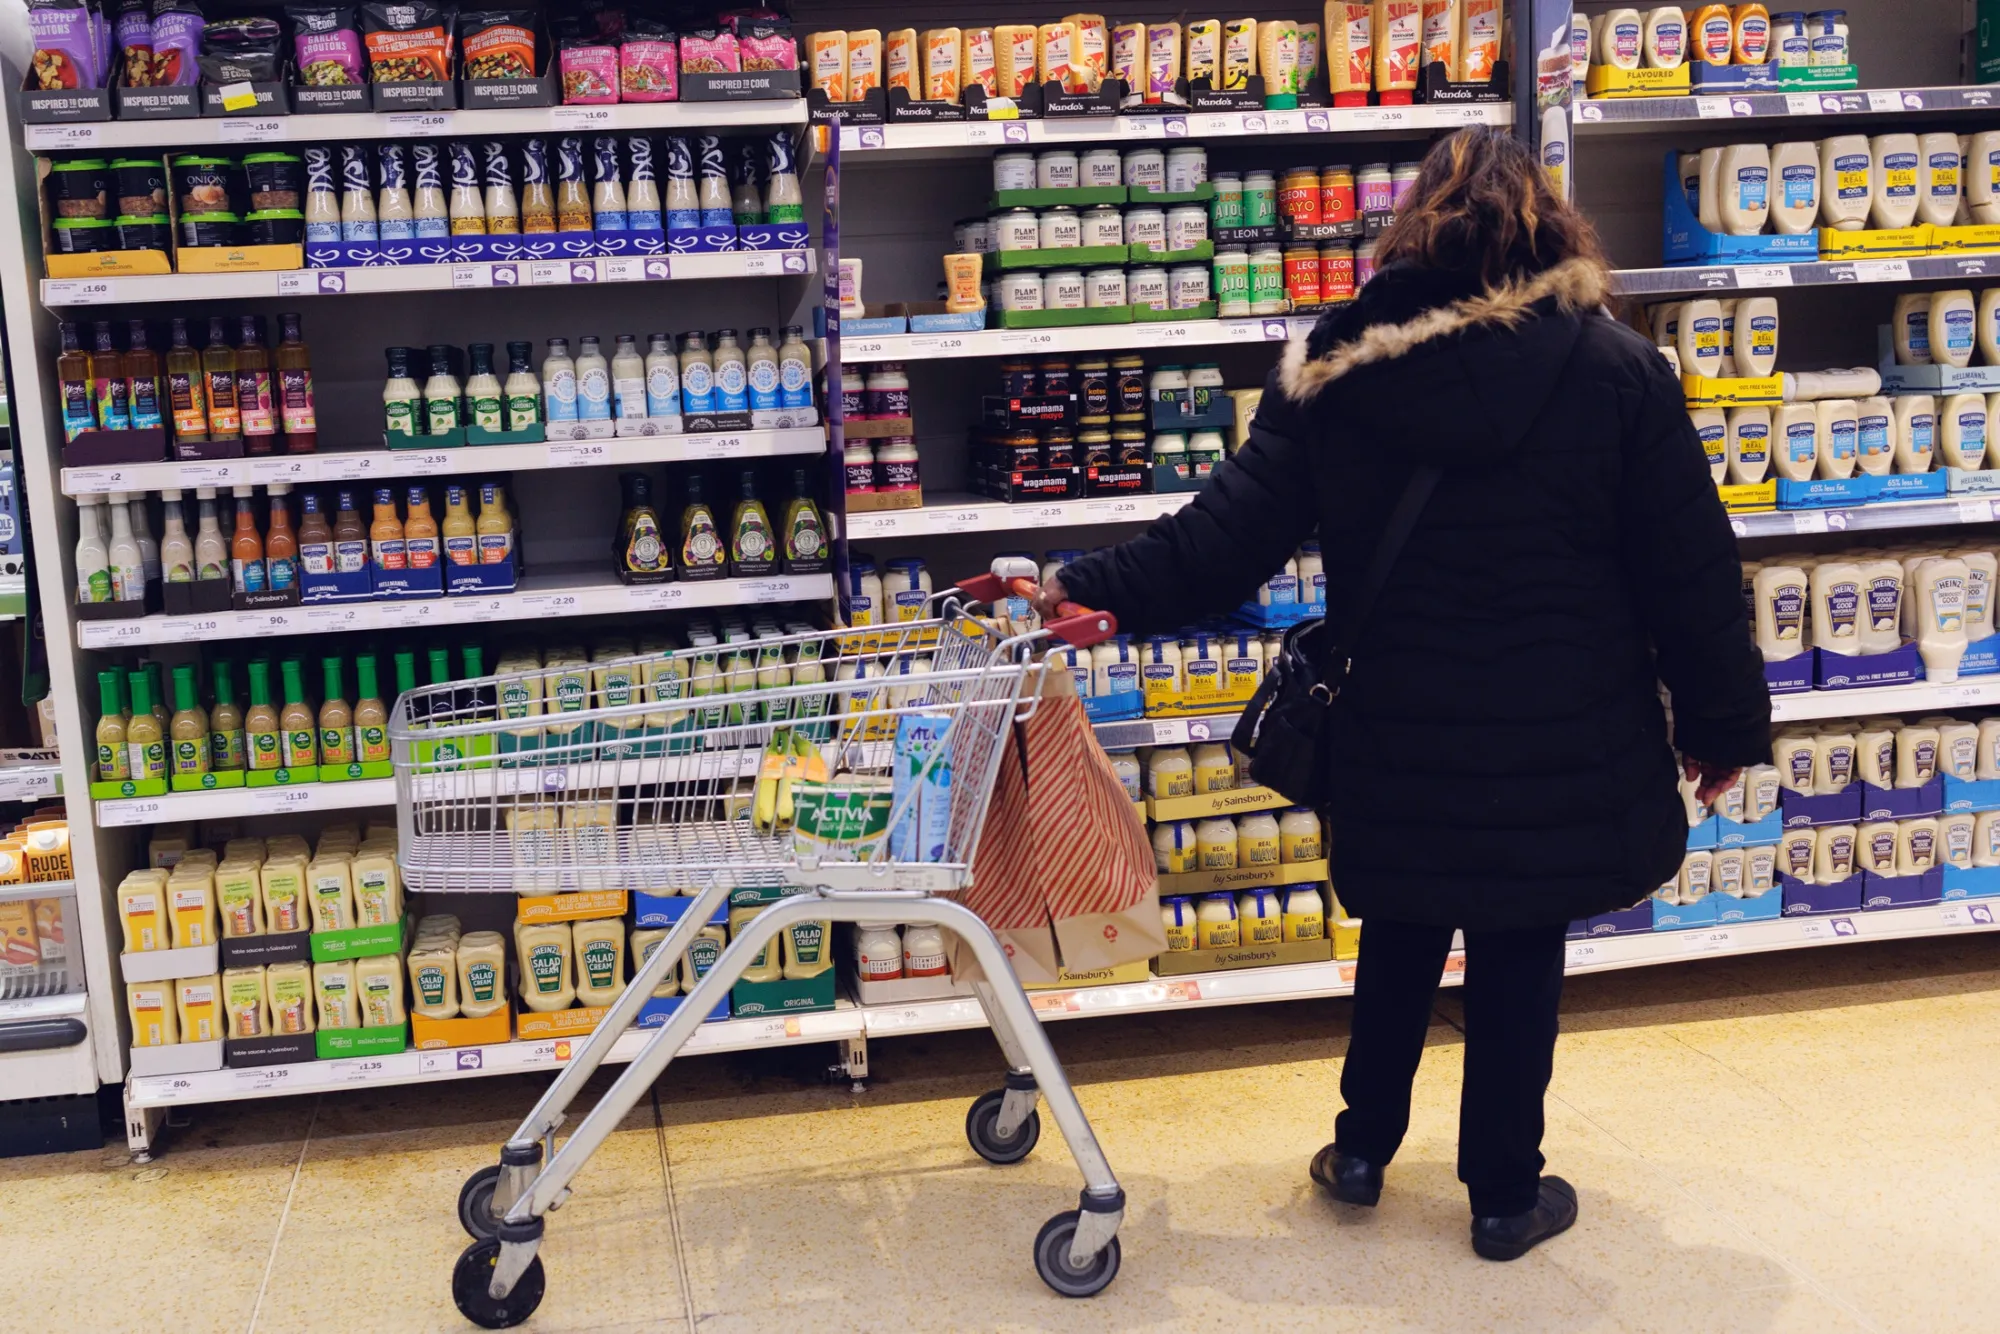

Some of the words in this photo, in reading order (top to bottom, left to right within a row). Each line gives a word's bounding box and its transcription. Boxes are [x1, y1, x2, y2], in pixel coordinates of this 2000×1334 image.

[42, 14, 77, 23] PEPPER
[308, 34, 339, 43] GARLIC
[377, 31, 435, 43] MEDITERRANEAN
[472, 28, 526, 44] MEDITERRANEAN
[410, 38, 445, 48] CROUTONS
[304, 43, 346, 54] CROUTONS
[1627, 71, 1674, 79] FLAVOURED
[708, 80, 741, 89] INSPIRED
[751, 79, 770, 88] COOK
[383, 87, 417, 97] INSPIRED
[426, 87, 443, 96] COOK
[474, 86, 509, 96] INSPIRED
[518, 84, 537, 93] COOK
[1434, 90, 1472, 98] Nando's
[299, 92, 332, 101] INSPIRED
[341, 90, 362, 99] COOK
[32, 98, 68, 109] INSPIRED
[78, 98, 99, 108] COOK
[124, 96, 159, 106] INSPIRED
[168, 95, 189, 104] COOK
[1197, 98, 1232, 106] Nando's
[1048, 103, 1083, 111] Nando's
[813, 110, 849, 118] Nando's
[896, 108, 931, 116] Nando's
[1836, 157, 1868, 166] HELLMANN'S
[187, 175, 226, 184] ONIONS
[1844, 176, 1863, 184] REAL
[1744, 185, 1763, 193] LIGHT
[1789, 184, 1810, 192] LIGHT
[1233, 229, 1258, 238] LEON
[1313, 226, 1337, 236] LEON
[1800, 238, 1810, 246] fat
[1258, 265, 1280, 274] LEON
[1297, 261, 1319, 270] LEON
[1328, 261, 1351, 269] LEON
[1021, 405, 1064, 413] wagamama
[848, 468, 872, 477] Stokes
[887, 466, 913, 475] Stokes
[1099, 473, 1141, 481] wagamama
[1024, 478, 1066, 487] wagamama
[1873, 580, 1895, 588] HEINZ
[1779, 588, 1800, 596] HEINZ
[1835, 586, 1855, 594] HEINZ
[254, 594, 288, 602] Sainsbury's
[1212, 799, 1222, 808] by
[1225, 792, 1273, 806] Sainsbury's
[811, 808, 873, 821] ACTIVIA
[32, 854, 68, 872] RUDE
[33, 871, 70, 883] HEALTH
[1213, 874, 1224, 884] by
[1225, 871, 1274, 882] Sainsbury's
[587, 954, 613, 962] SALAD
[1215, 954, 1226, 964] by
[1228, 950, 1276, 962] Sainsbury's
[533, 958, 560, 967] SALAD
[536, 966, 559, 974] CREAM
[1064, 969, 1114, 980] Sainsbury's
[421, 976, 442, 984] SALAD
[784, 998, 815, 1007] ORIGINAL
